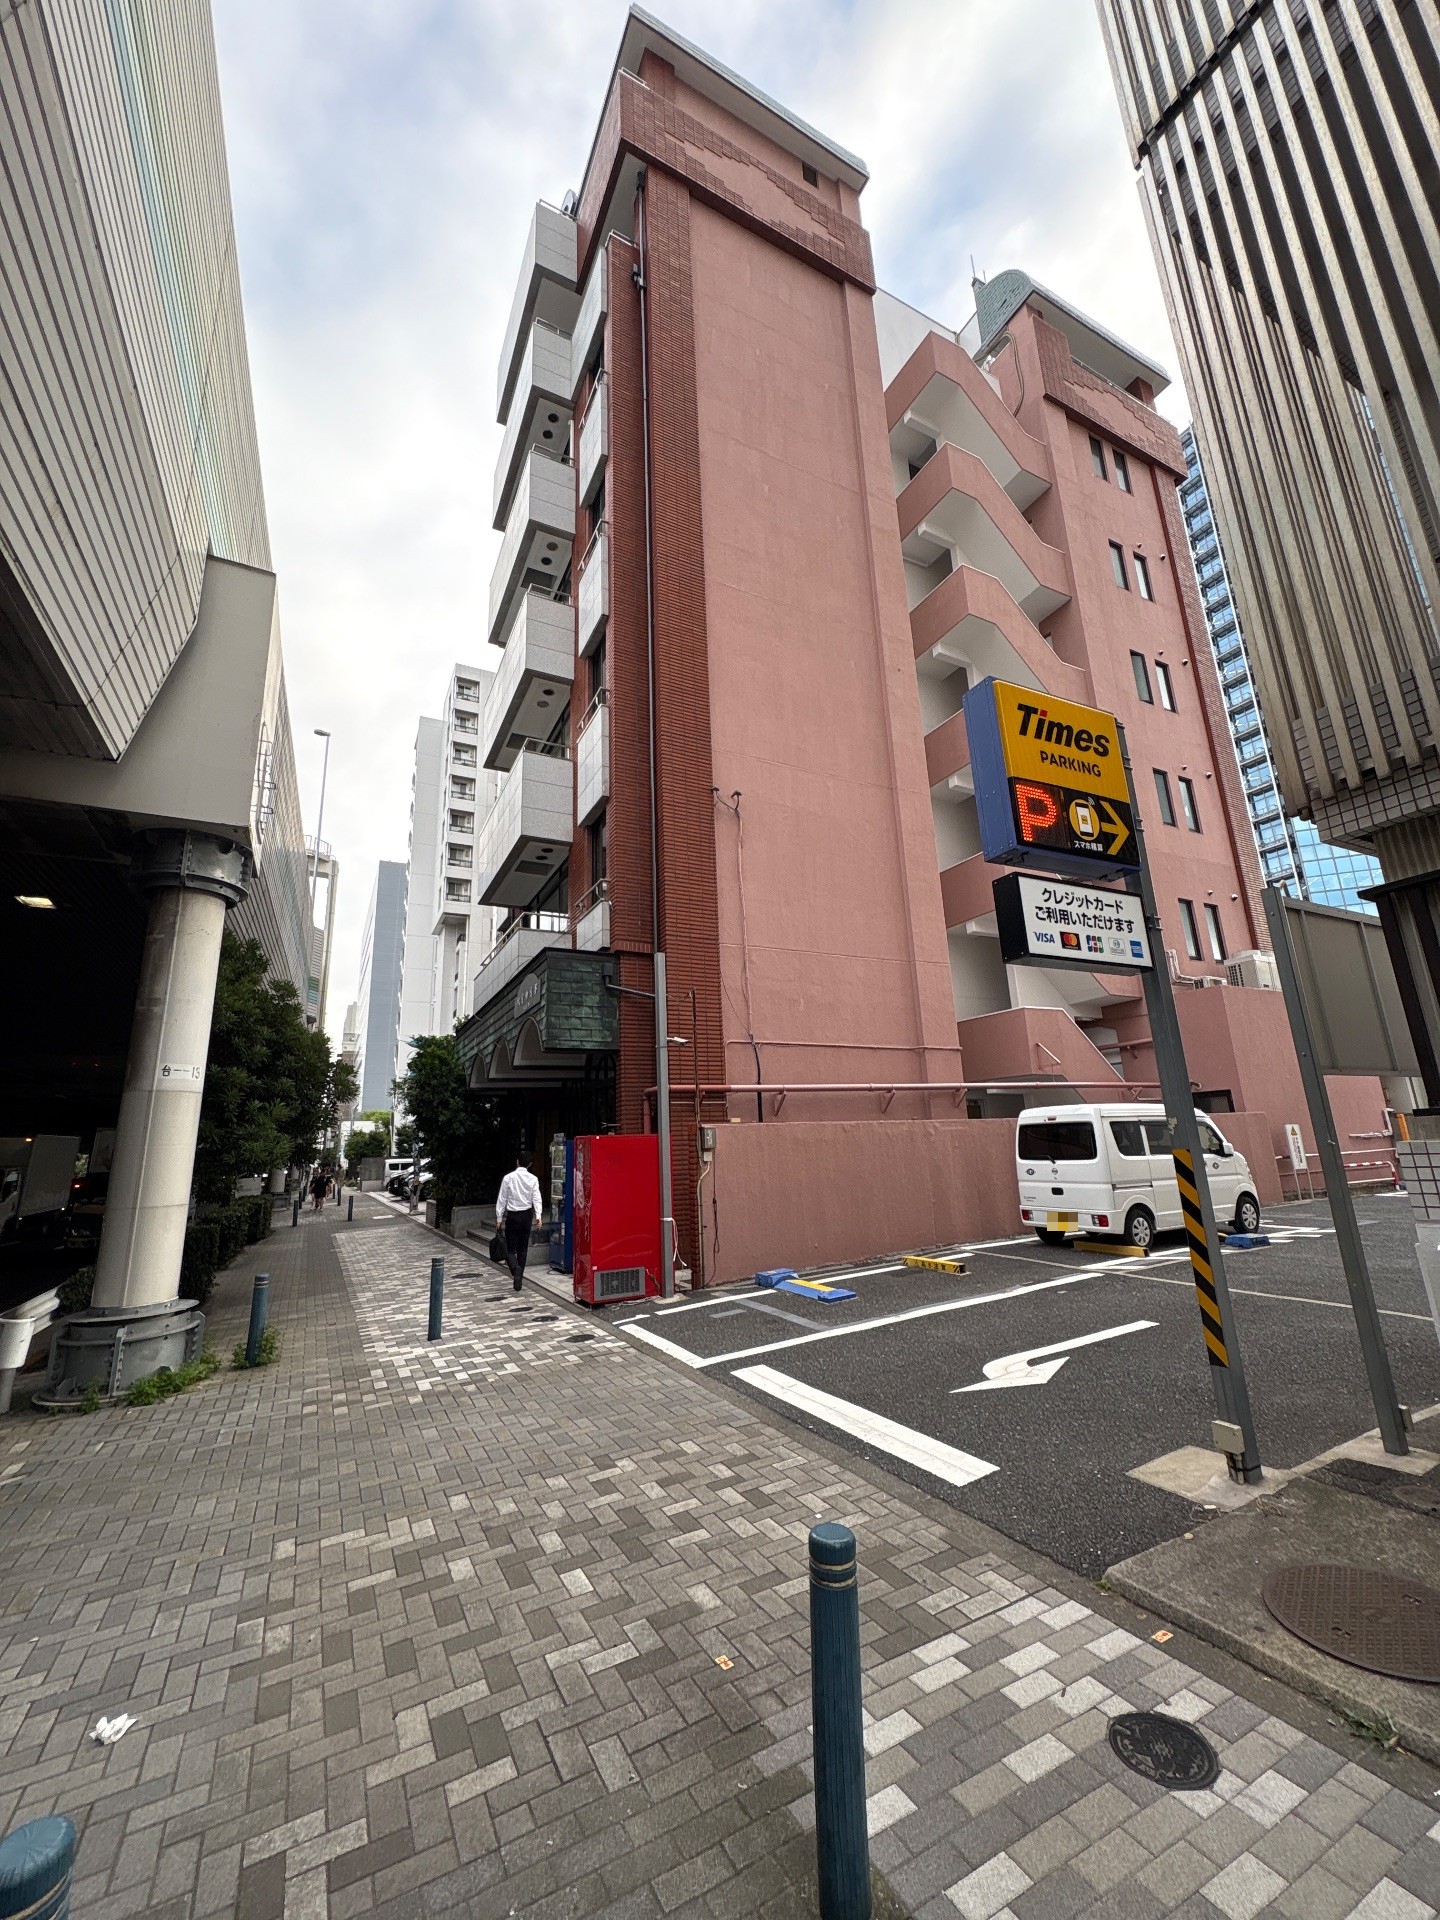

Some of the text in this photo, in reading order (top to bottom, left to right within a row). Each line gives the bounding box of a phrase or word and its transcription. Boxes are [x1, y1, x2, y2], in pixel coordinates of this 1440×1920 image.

[1017, 703, 1110, 757] Times
[1040, 751, 1101, 777] PARKING
[1015, 783, 1057, 842] P
[1042, 888, 1123, 914] クレジットカード
[1035, 906, 1135, 934] ご利用いただけます
[1033, 931, 1056, 944] VISA
